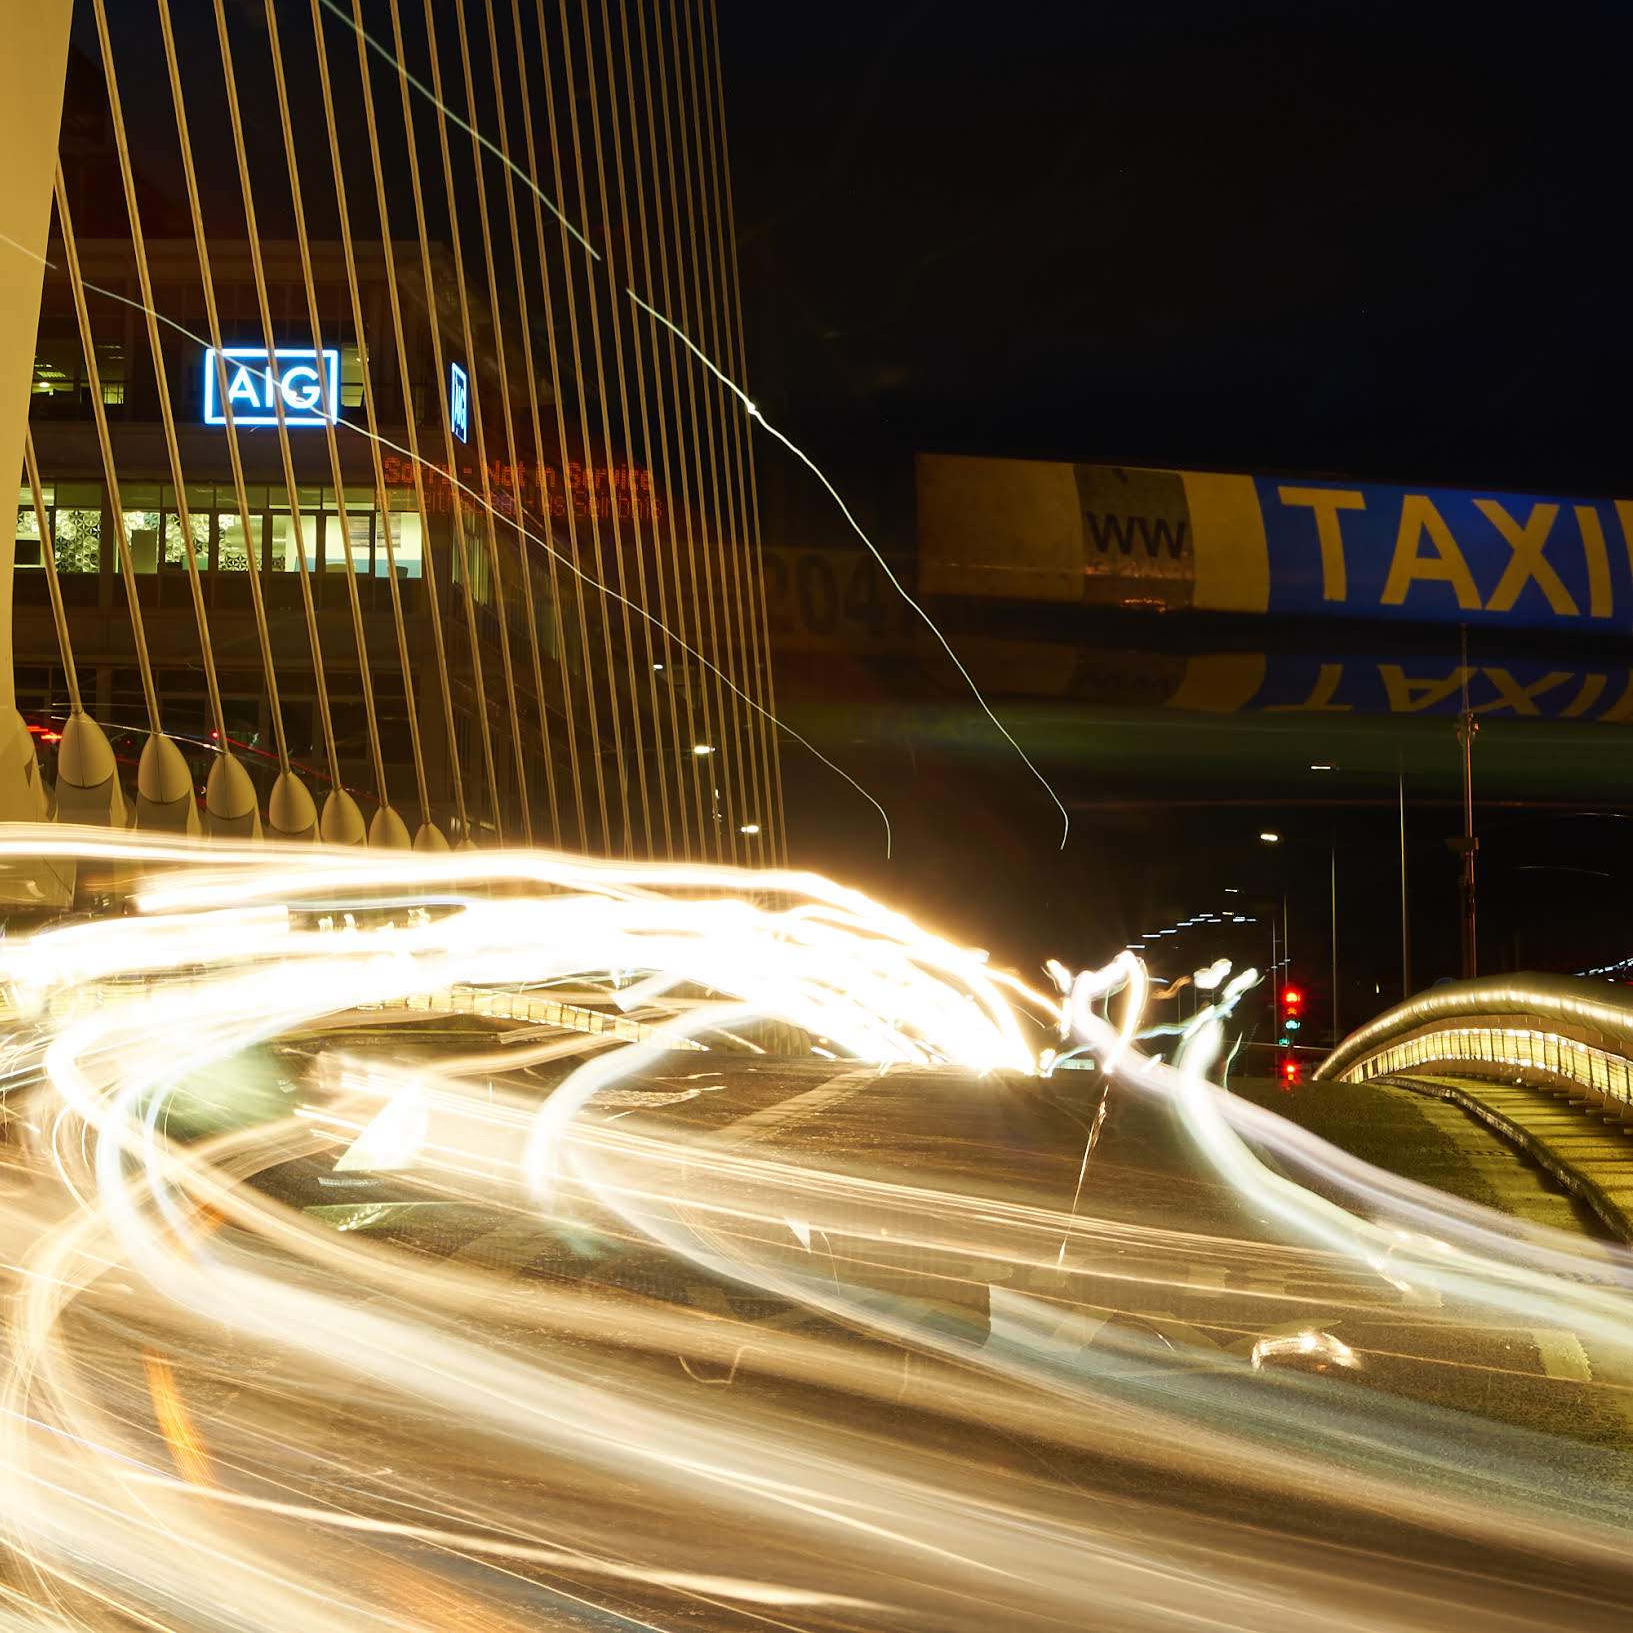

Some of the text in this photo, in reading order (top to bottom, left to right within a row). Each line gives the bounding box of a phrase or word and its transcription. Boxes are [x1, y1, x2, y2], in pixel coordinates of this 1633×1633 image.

[226, 366, 321, 410] AIG
[483, 459, 526, 488] Not
[567, 462, 652, 491] Service
[1277, 485, 1614, 619] TAXI
